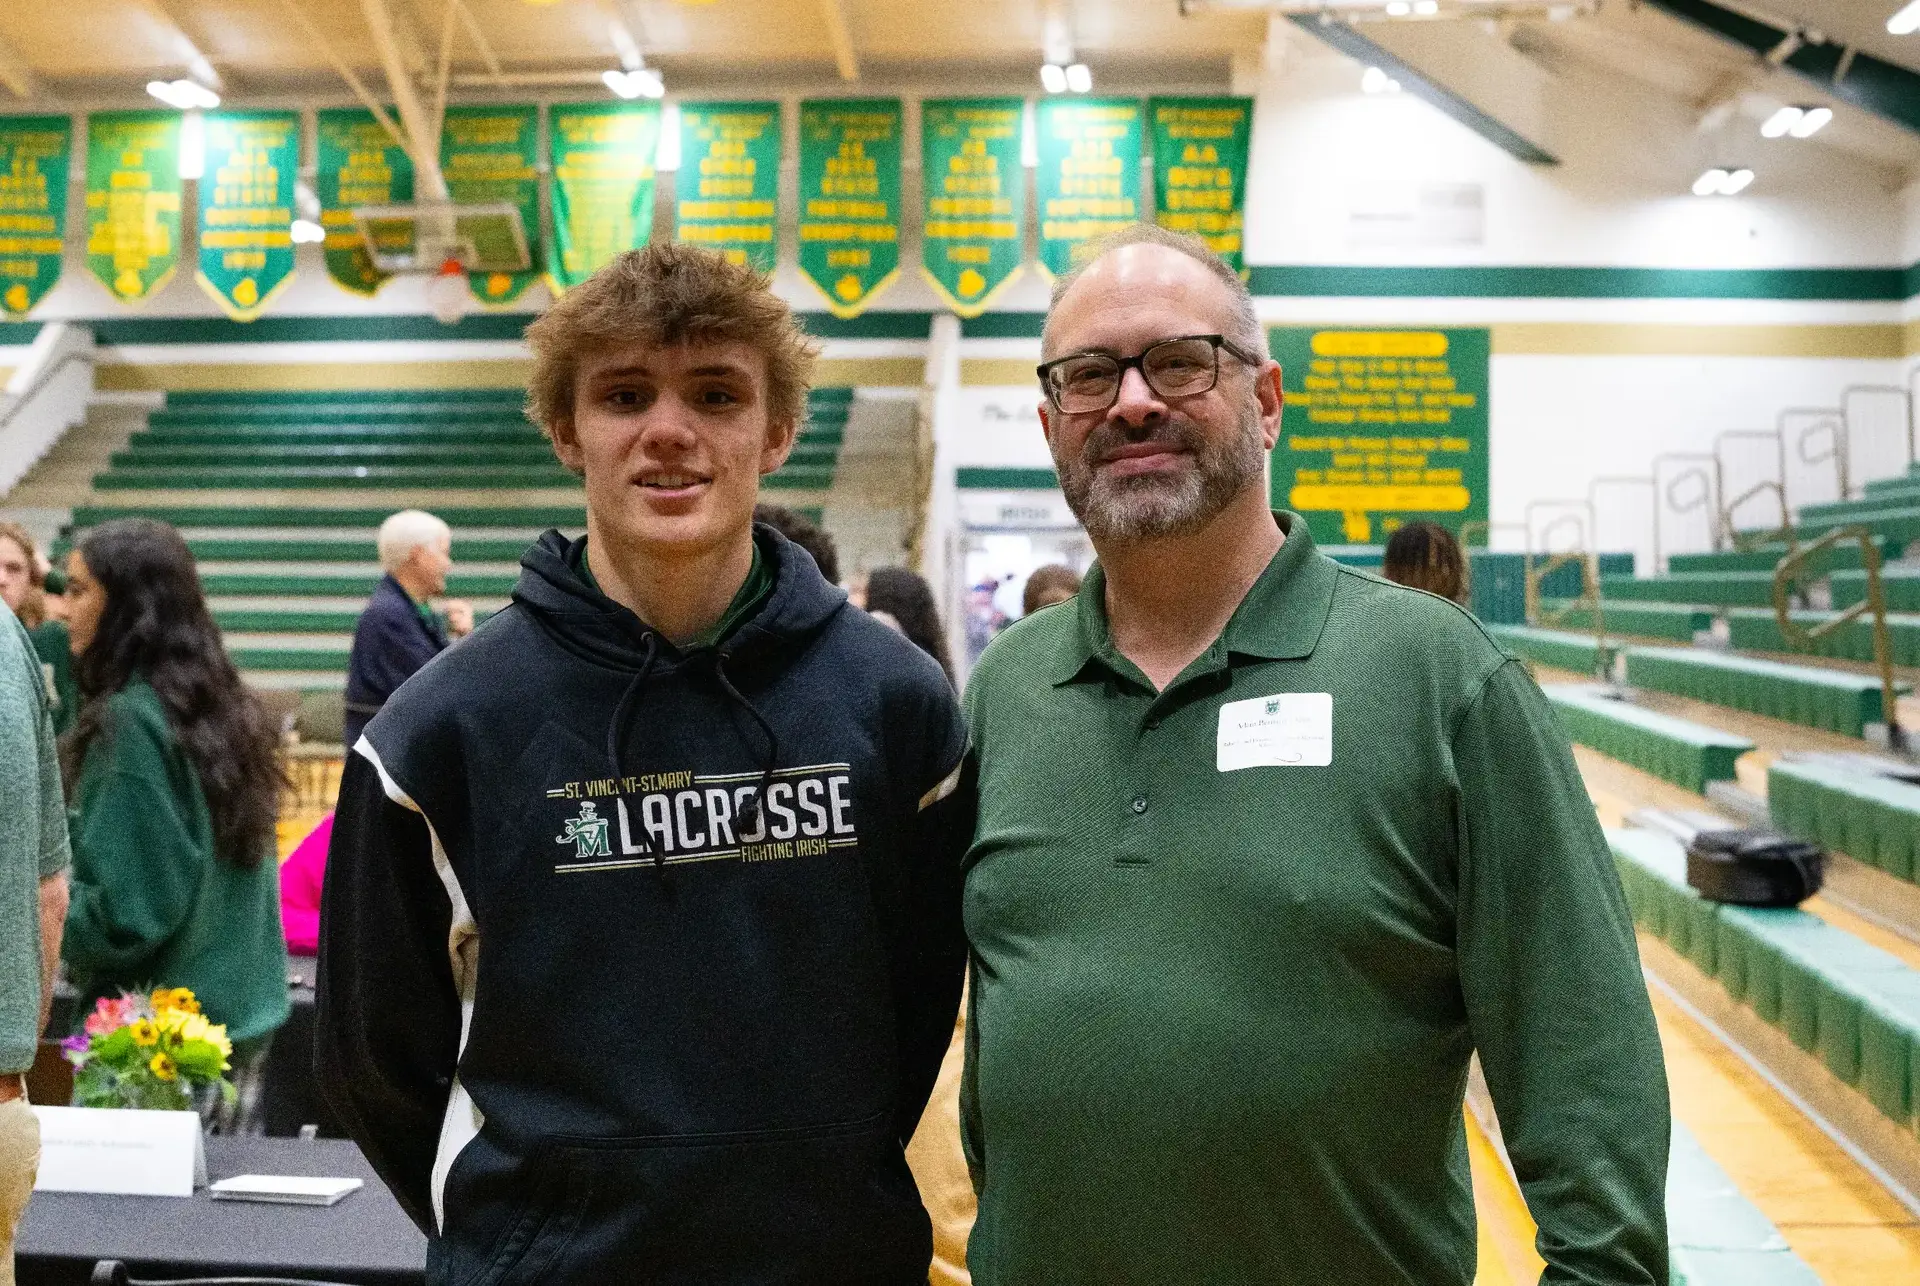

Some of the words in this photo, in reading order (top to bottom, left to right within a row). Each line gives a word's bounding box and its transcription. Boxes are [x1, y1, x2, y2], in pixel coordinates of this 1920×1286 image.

[564, 781, 583, 799] ST.
[586, 770, 692, 797] VINCNT-ST.MARY
[617, 775, 855, 856] LACROSSE
[741, 841, 794, 863] FIGHTING
[796, 838, 828, 857] IRISH
